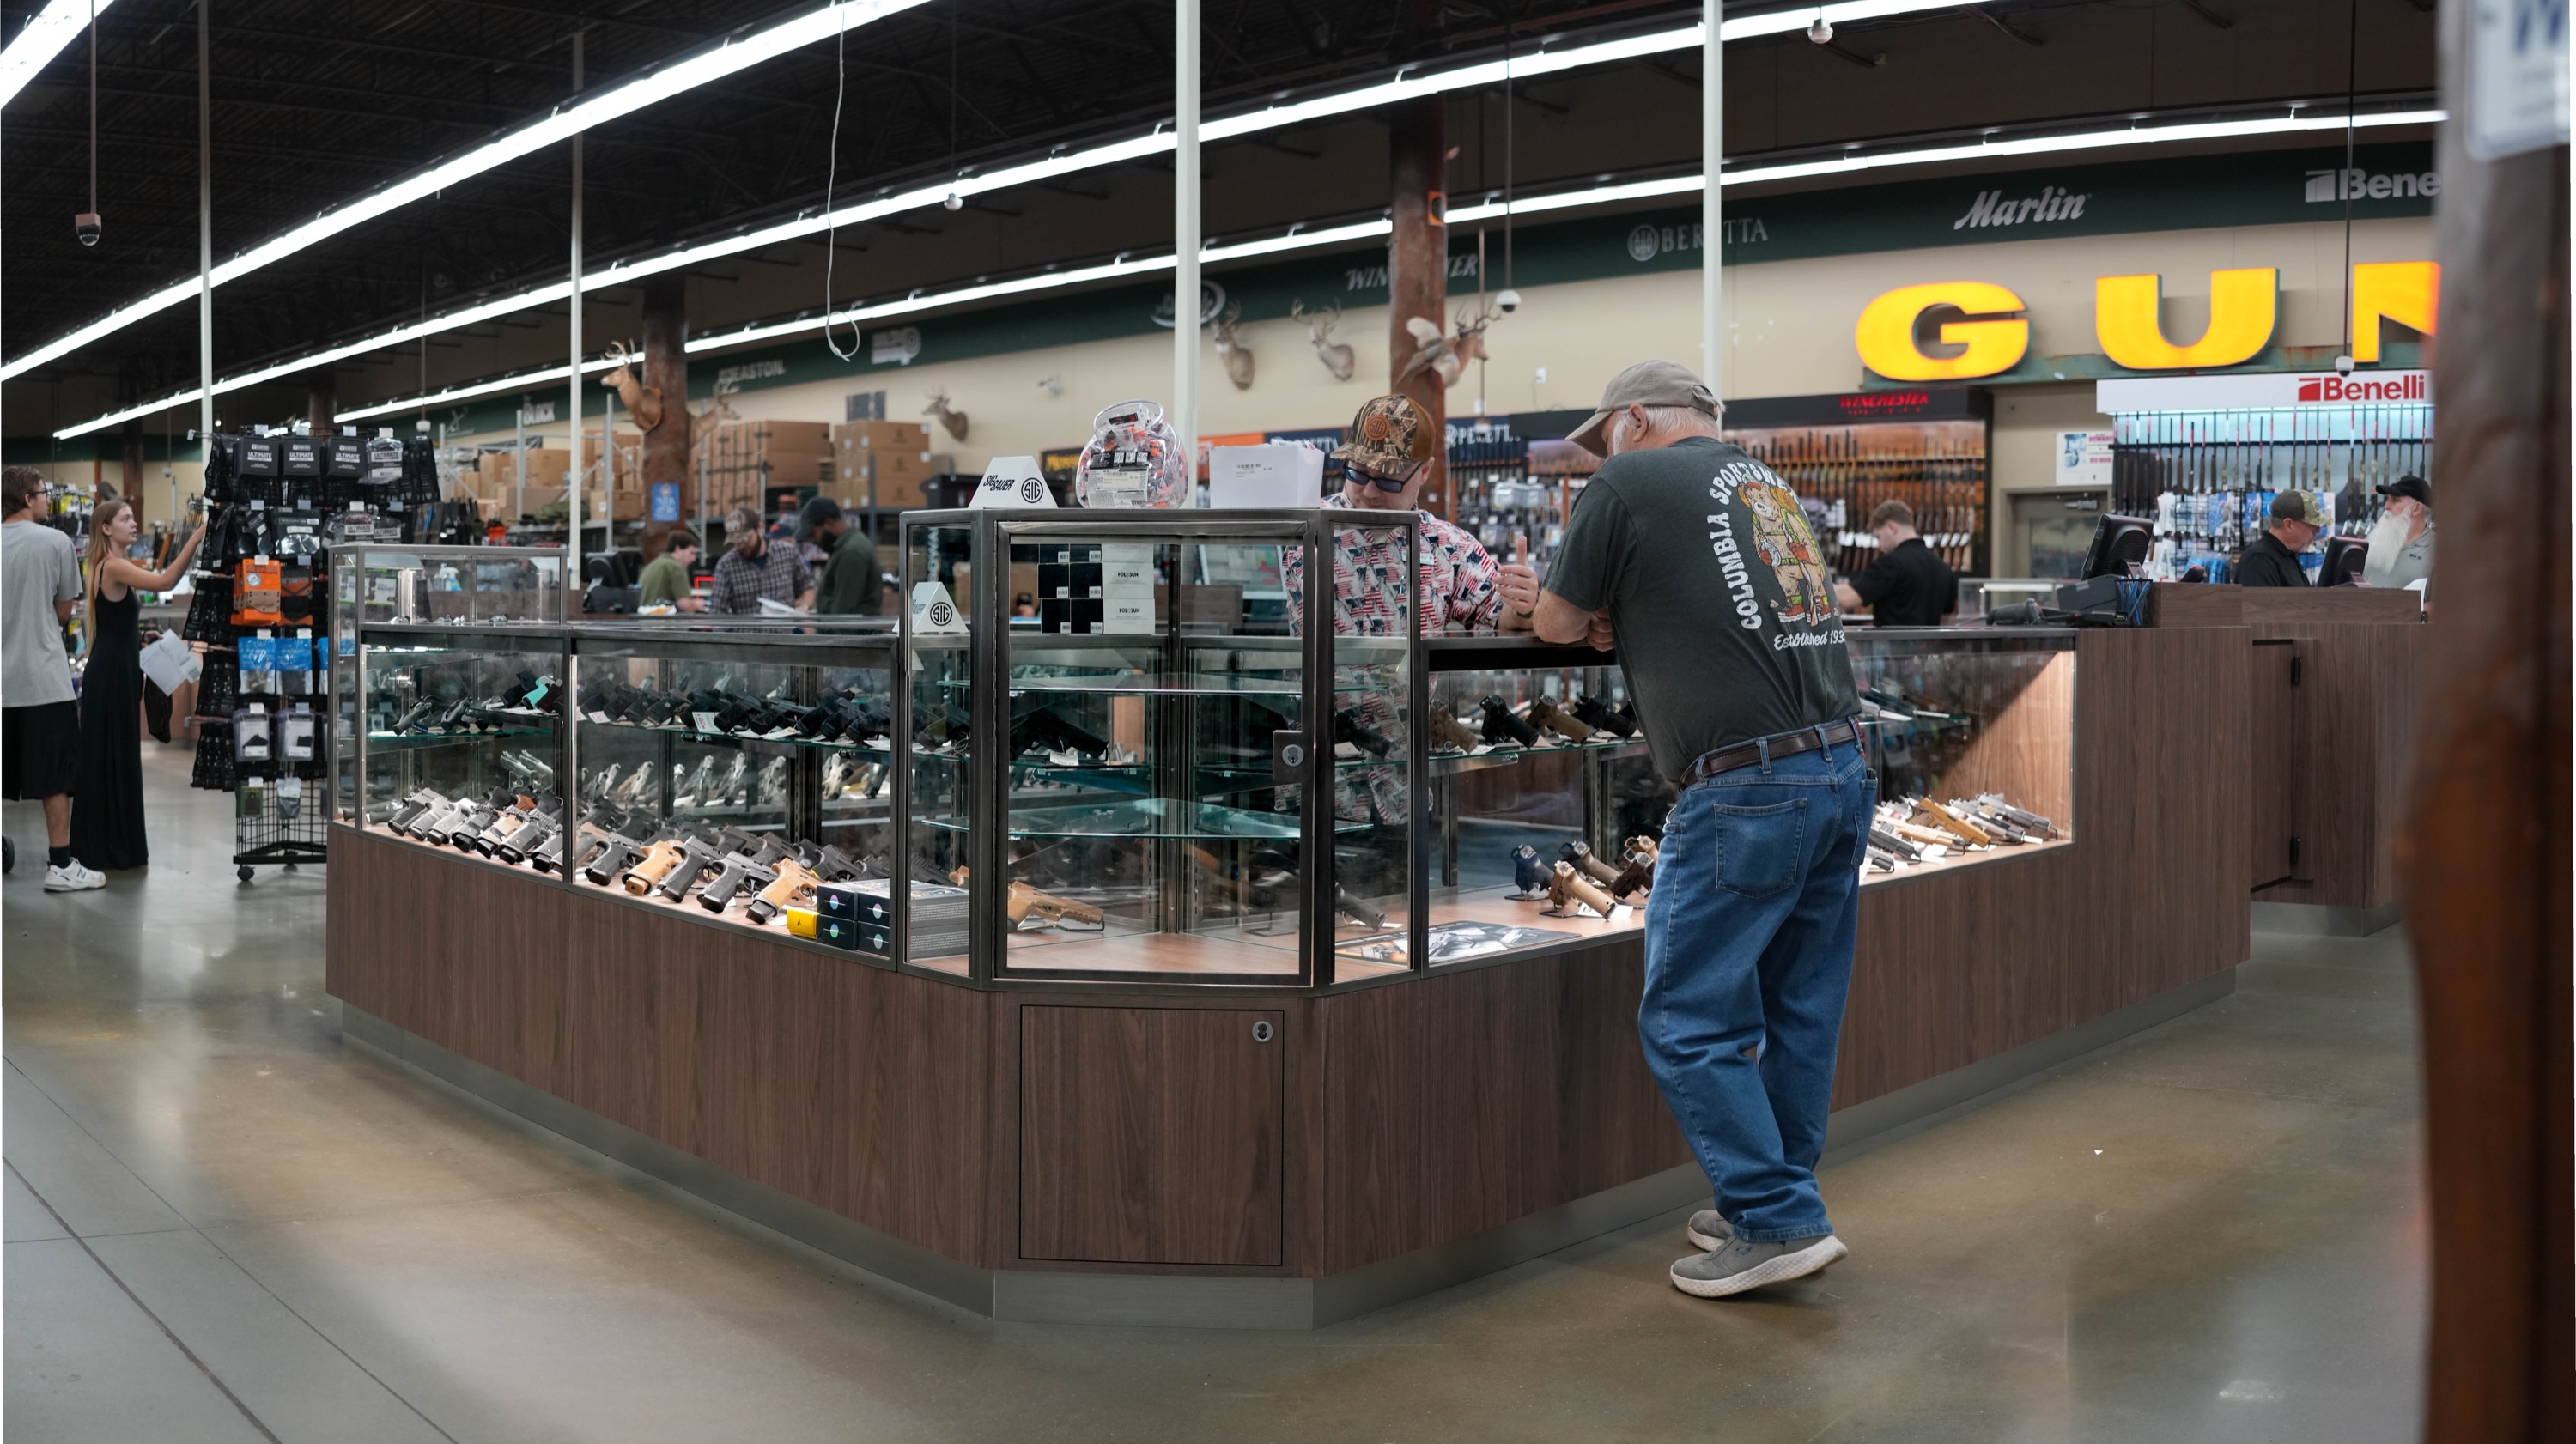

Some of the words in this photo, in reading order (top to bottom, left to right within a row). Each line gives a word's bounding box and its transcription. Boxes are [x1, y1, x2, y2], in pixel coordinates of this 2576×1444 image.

[1953, 186, 2086, 230] Marlin
[1662, 217, 1769, 252] BERTTA
[1346, 253, 1479, 291] WINTER
[2324, 374, 2425, 401] Benelli
[1367, 416, 1388, 439] SIG
[983, 475, 997, 487] SIG
[990, 479, 1015, 491] SAUER
[1023, 480, 1042, 501] SIG
[1707, 512, 1763, 630] COLUMBIA
[932, 604, 951, 624] SIG
[1774, 630, 1829, 651] Established
[1830, 630, 1846, 644] 193
